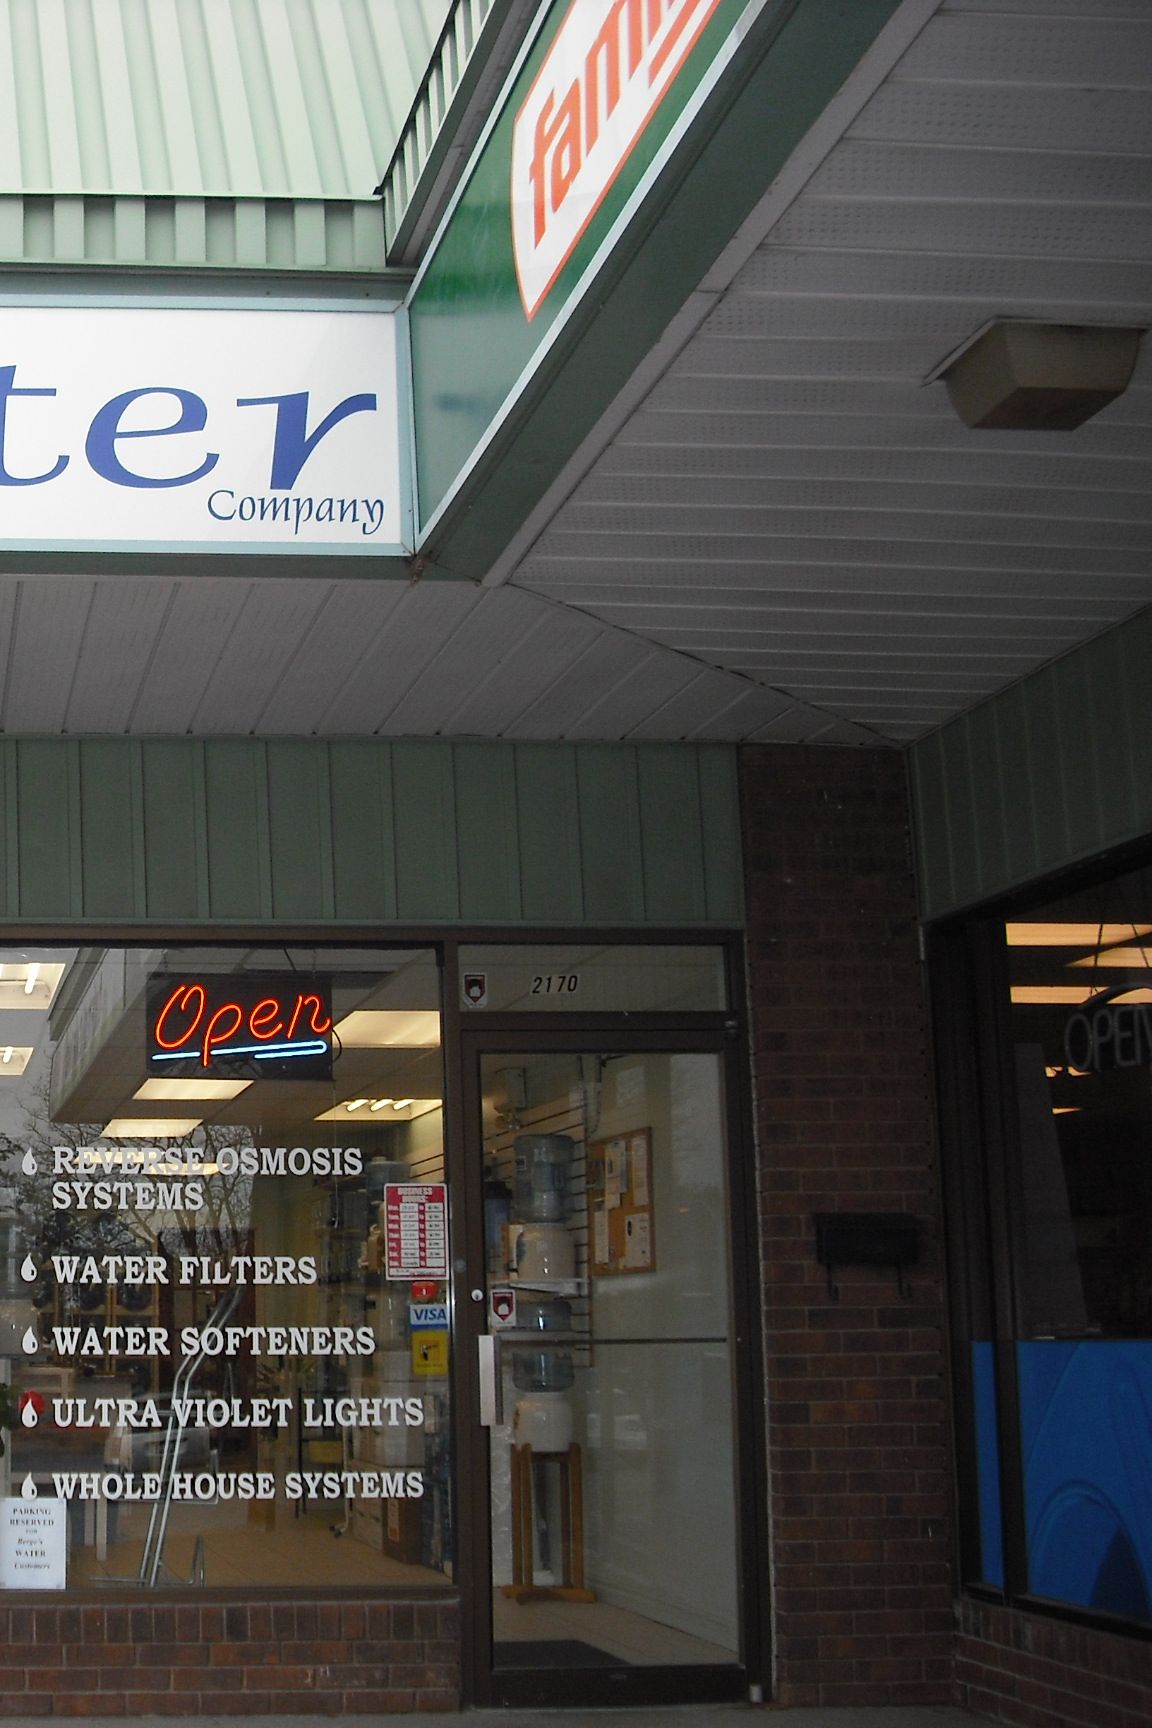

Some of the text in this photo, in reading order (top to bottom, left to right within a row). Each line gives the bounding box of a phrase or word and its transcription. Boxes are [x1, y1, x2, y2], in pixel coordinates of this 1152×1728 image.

[207, 489, 385, 535] Company
[531, 975, 579, 994] 2170
[154, 983, 332, 1068] Open
[52, 1145, 364, 1177] REVERSE OSMOSIS
[52, 1181, 205, 1211] SYSTEMS
[51, 1255, 318, 1286] WATER FILTERS
[413, 1308, 447, 1321] VISA
[51, 1326, 377, 1357] WATER SOFTENERS
[51, 1398, 425, 1429] ULTRA VIOLET LIGHTS
[51, 1471, 425, 1500] WHOLE HOUSE SYSTEMS
